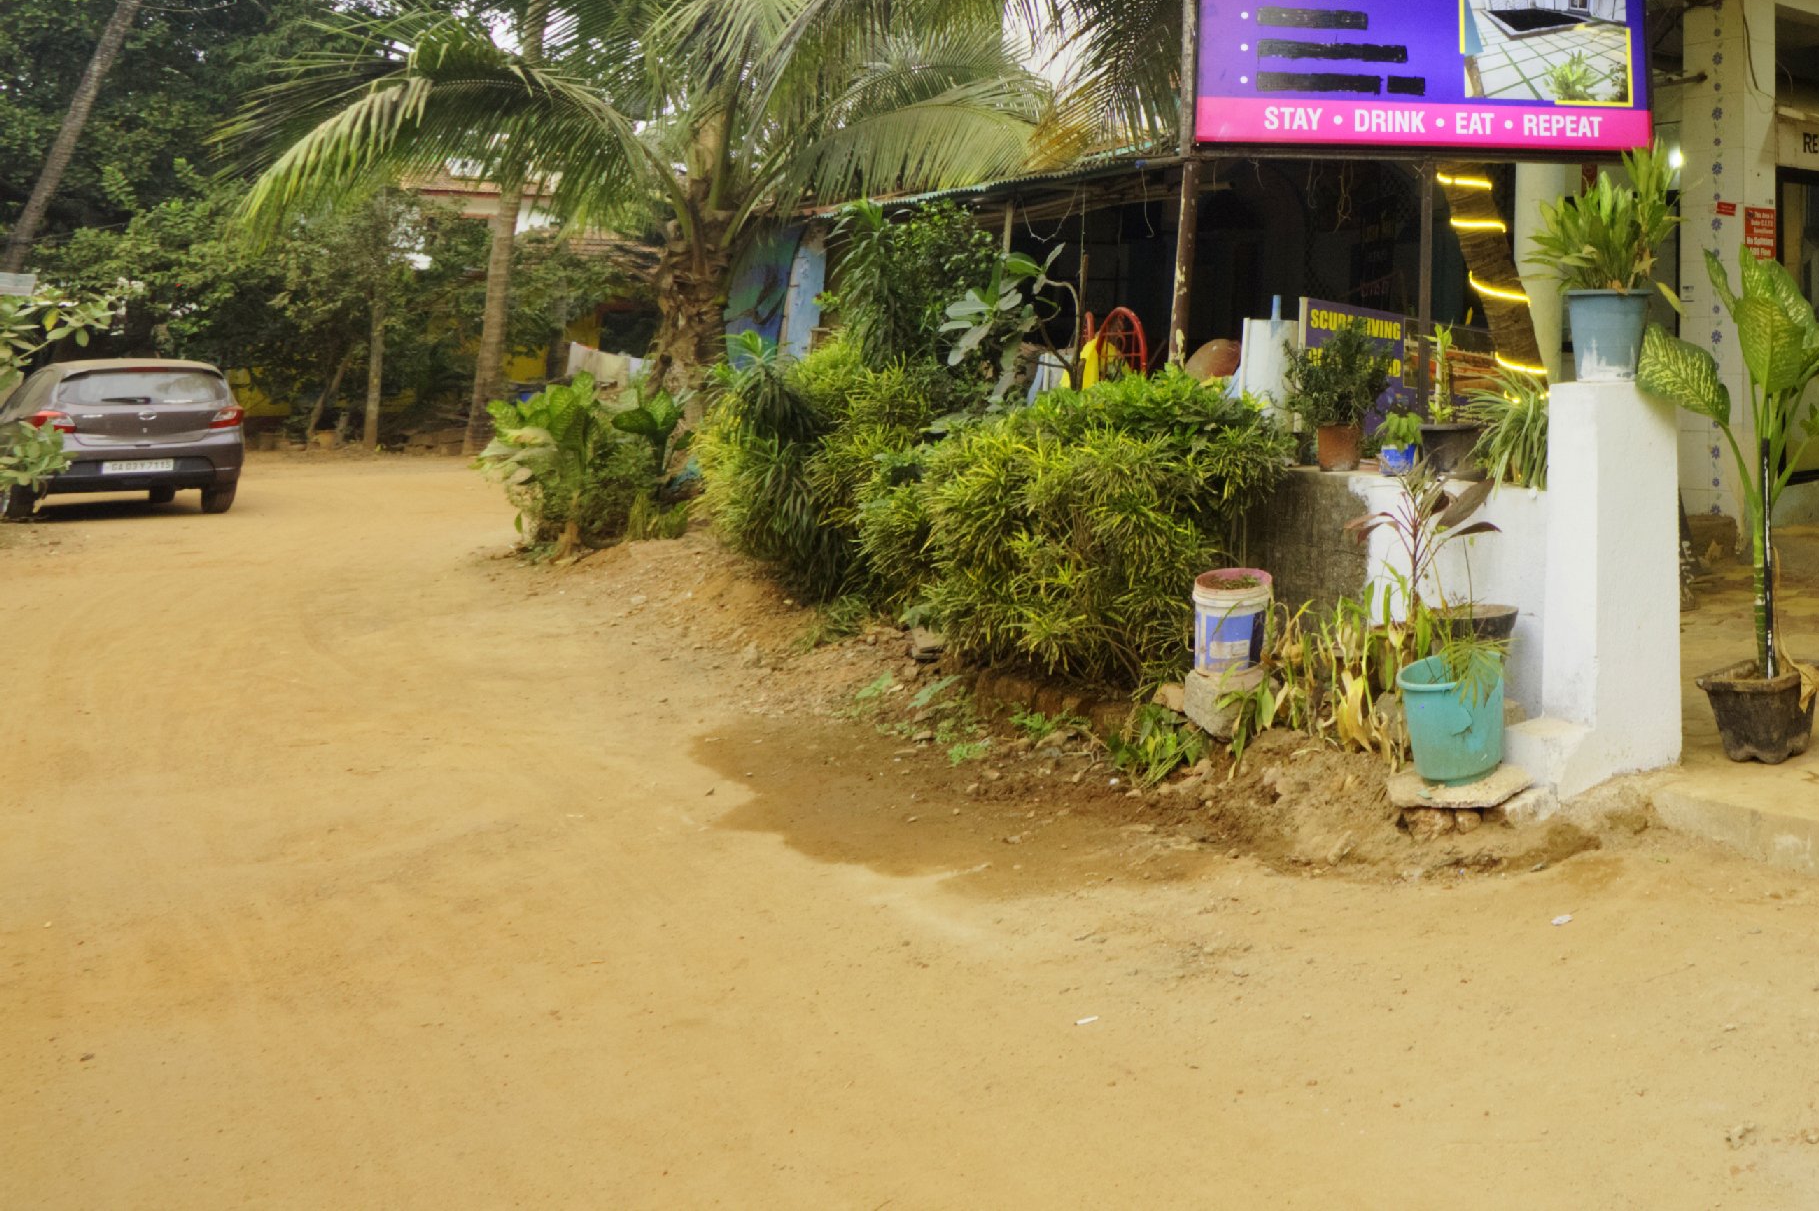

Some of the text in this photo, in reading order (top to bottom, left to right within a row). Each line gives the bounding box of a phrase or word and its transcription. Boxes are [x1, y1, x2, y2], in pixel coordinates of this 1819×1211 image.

[1264, 106, 1603, 138] STAY DRINK EAT REPEAT
